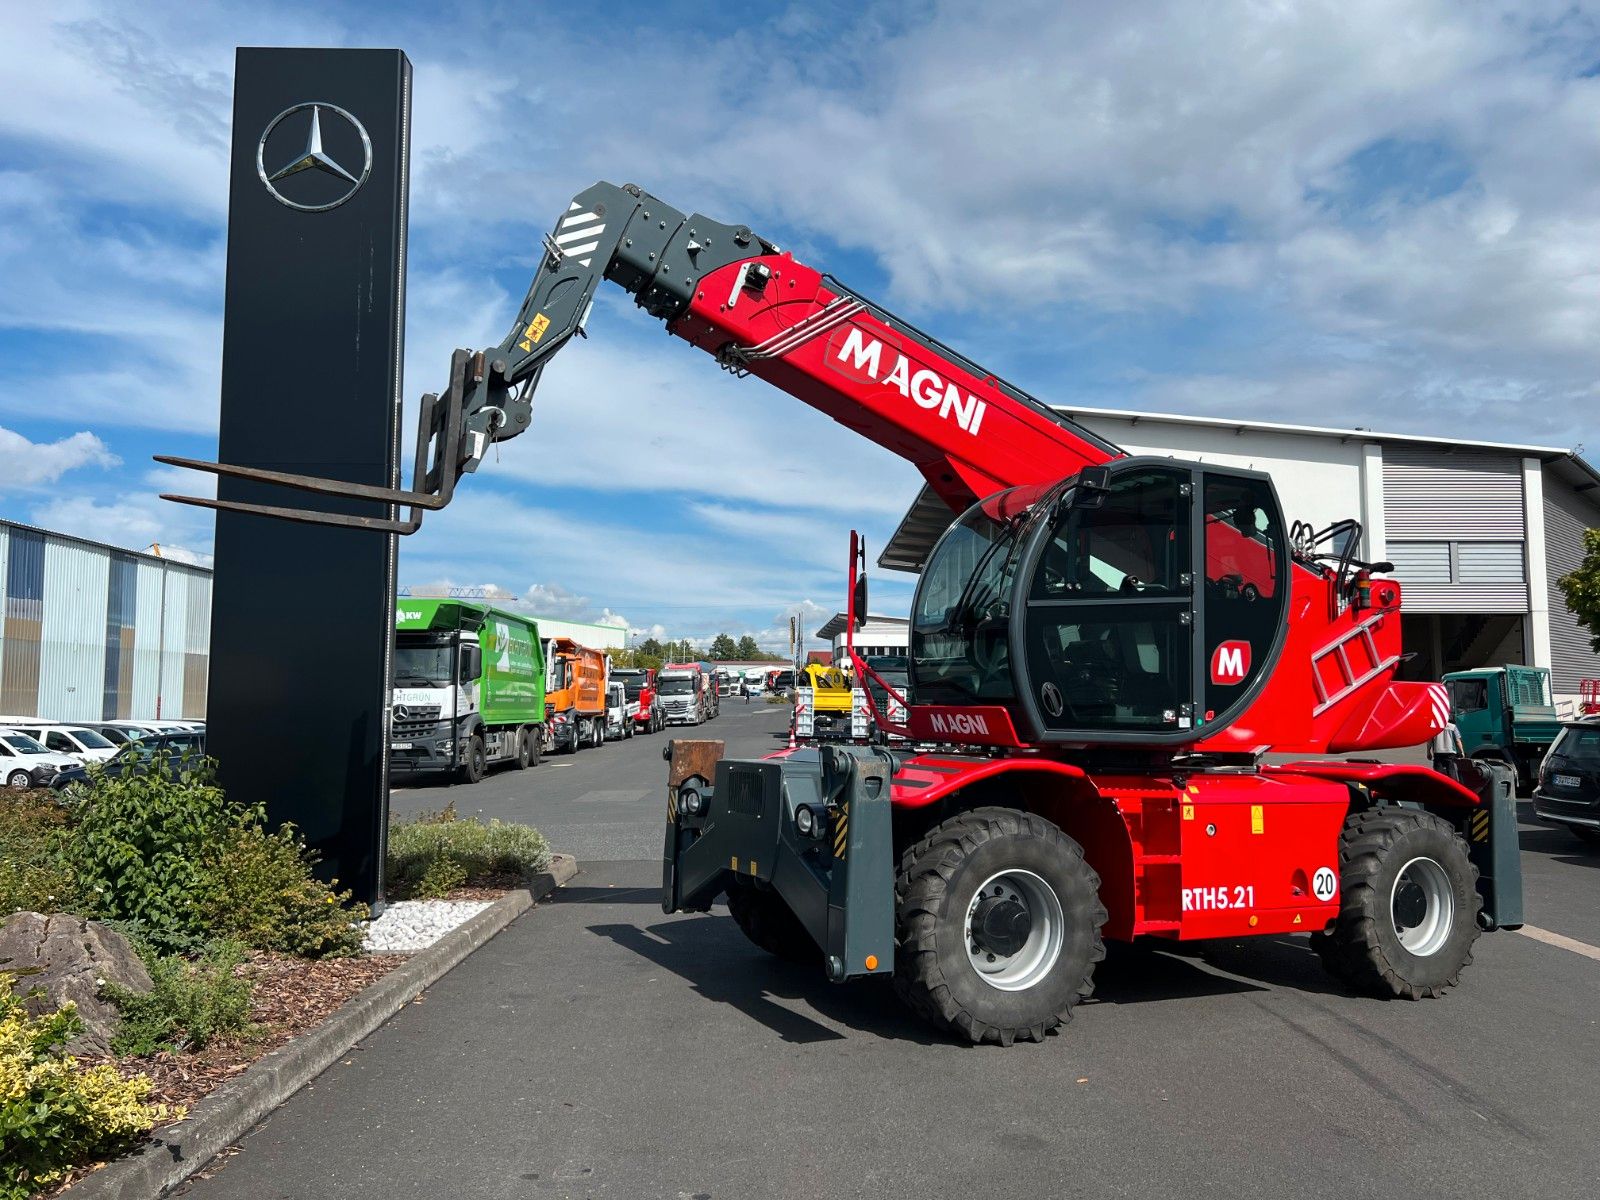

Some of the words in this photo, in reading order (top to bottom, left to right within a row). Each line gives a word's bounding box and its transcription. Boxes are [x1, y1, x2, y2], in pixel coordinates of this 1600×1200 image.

[837, 327, 987, 437] MAGNI
[1217, 647, 1244, 677] M
[930, 713, 990, 735] MAGNI
[1316, 873, 1334, 895] 20
[1181, 885, 1254, 912] RTH5.21
